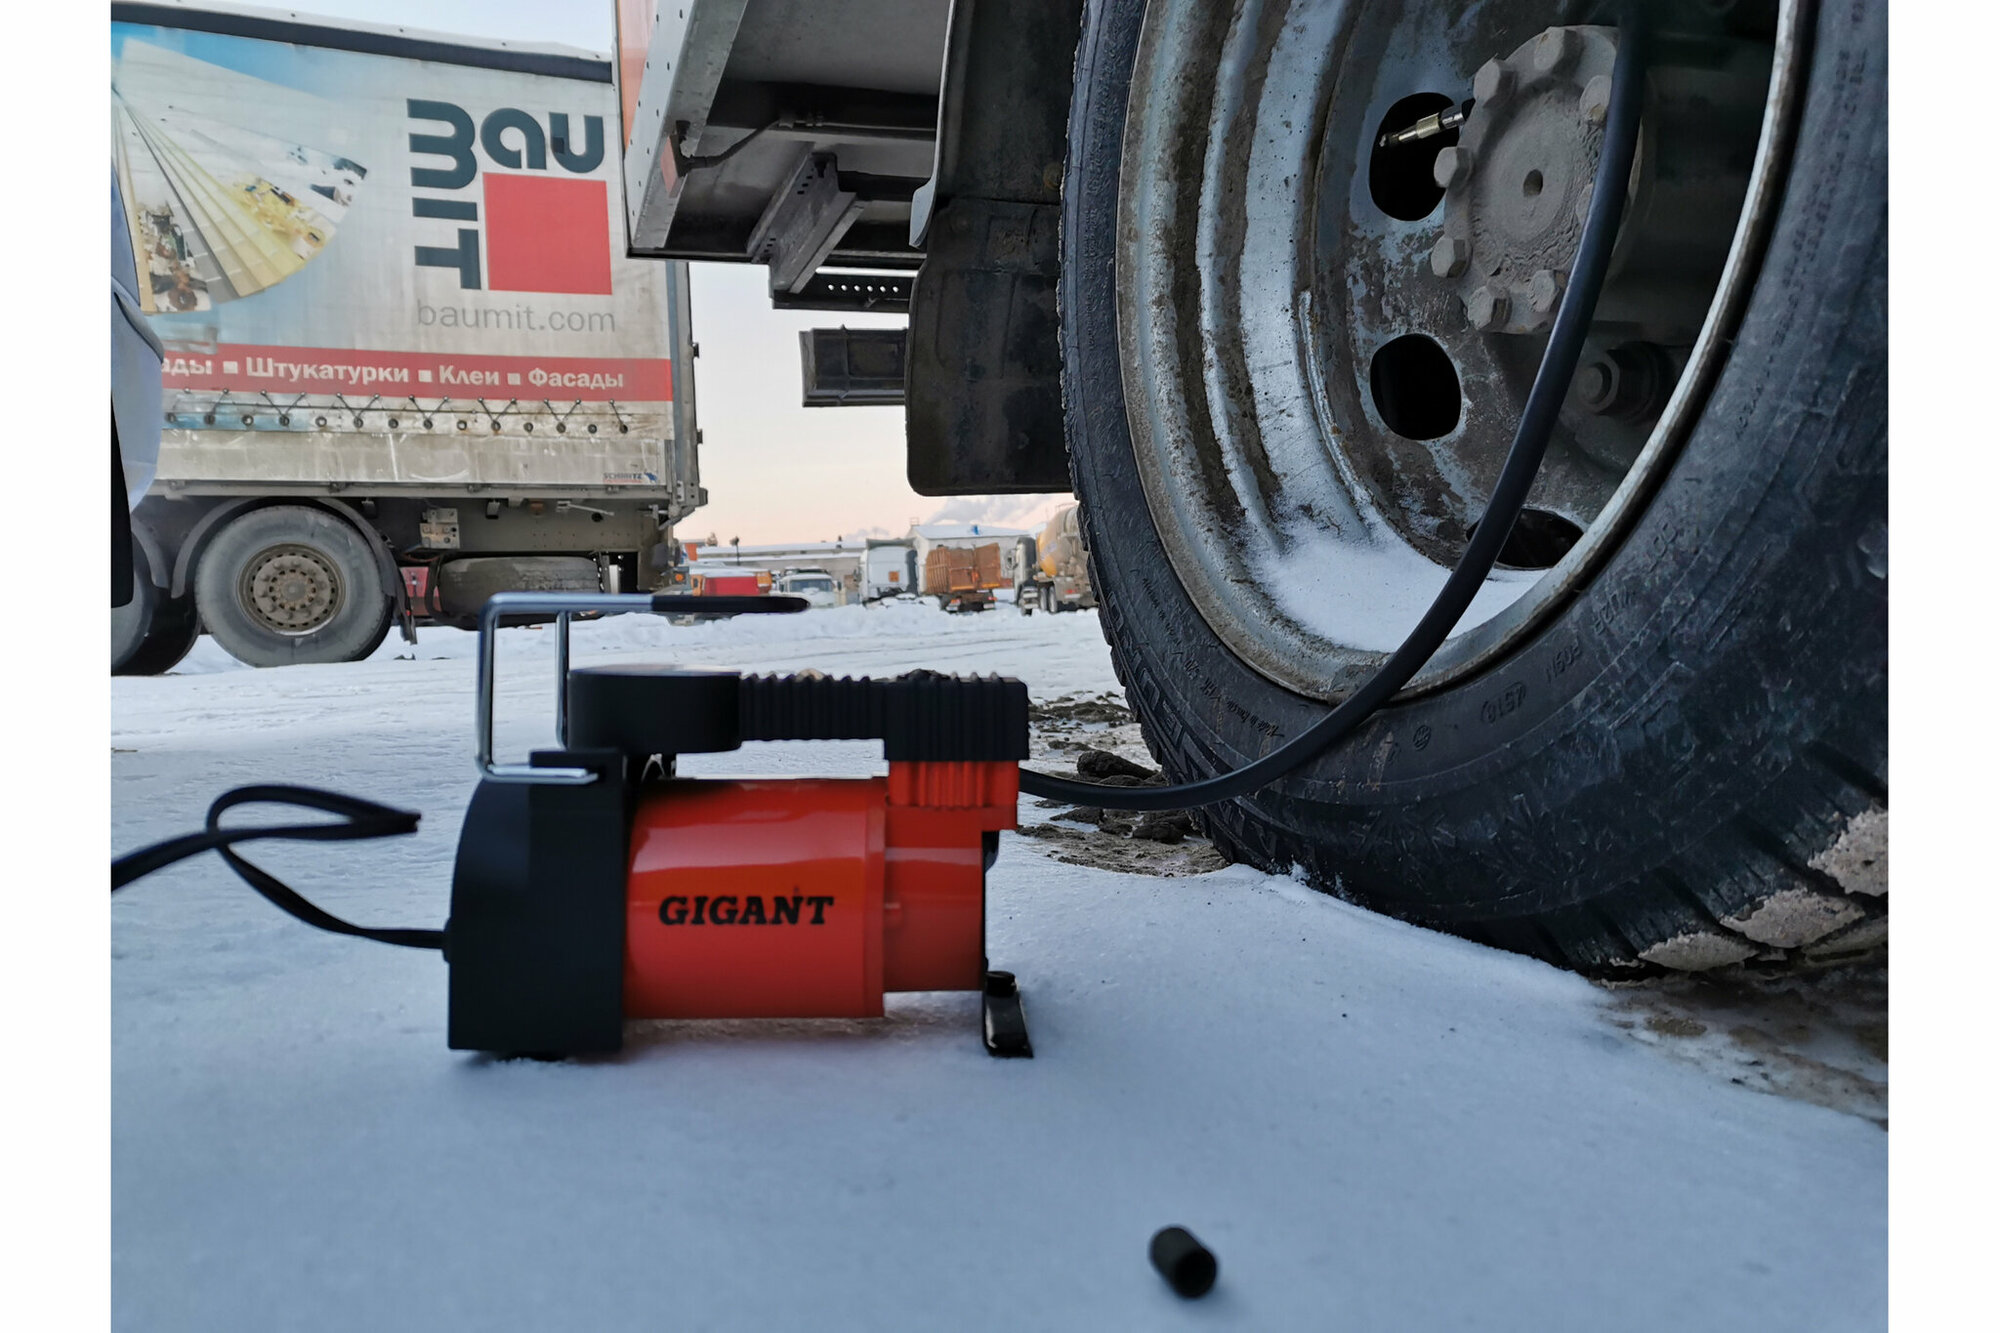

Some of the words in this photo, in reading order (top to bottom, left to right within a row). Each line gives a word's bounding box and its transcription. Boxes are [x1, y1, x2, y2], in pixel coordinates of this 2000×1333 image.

[417, 299, 616, 333] baumit.com
[246, 356, 410, 386] Штукатурки
[439, 364, 500, 386] Клеи
[528, 367, 624, 390] Фасады
[658, 895, 834, 926] GIGANT
